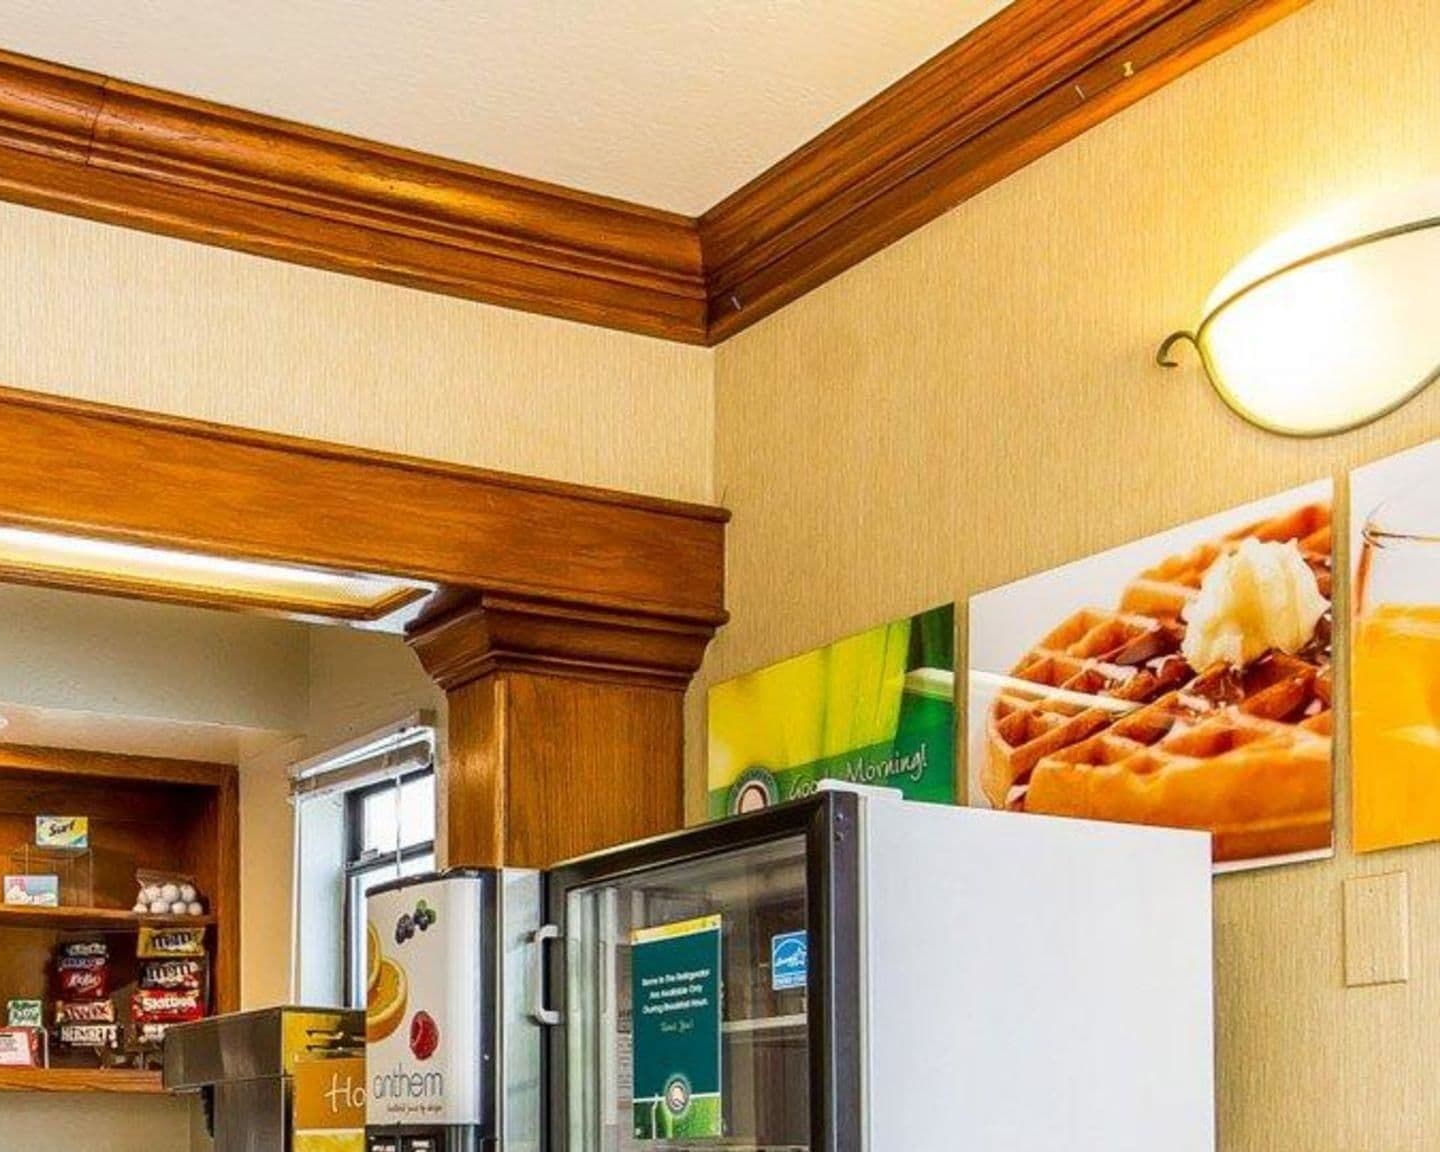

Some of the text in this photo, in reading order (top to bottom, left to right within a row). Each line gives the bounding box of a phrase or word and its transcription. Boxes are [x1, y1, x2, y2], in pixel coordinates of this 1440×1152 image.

[844, 743, 928, 781] Morning!
[324, 1072, 367, 1113] Ho
[372, 1063, 443, 1100] anthem
